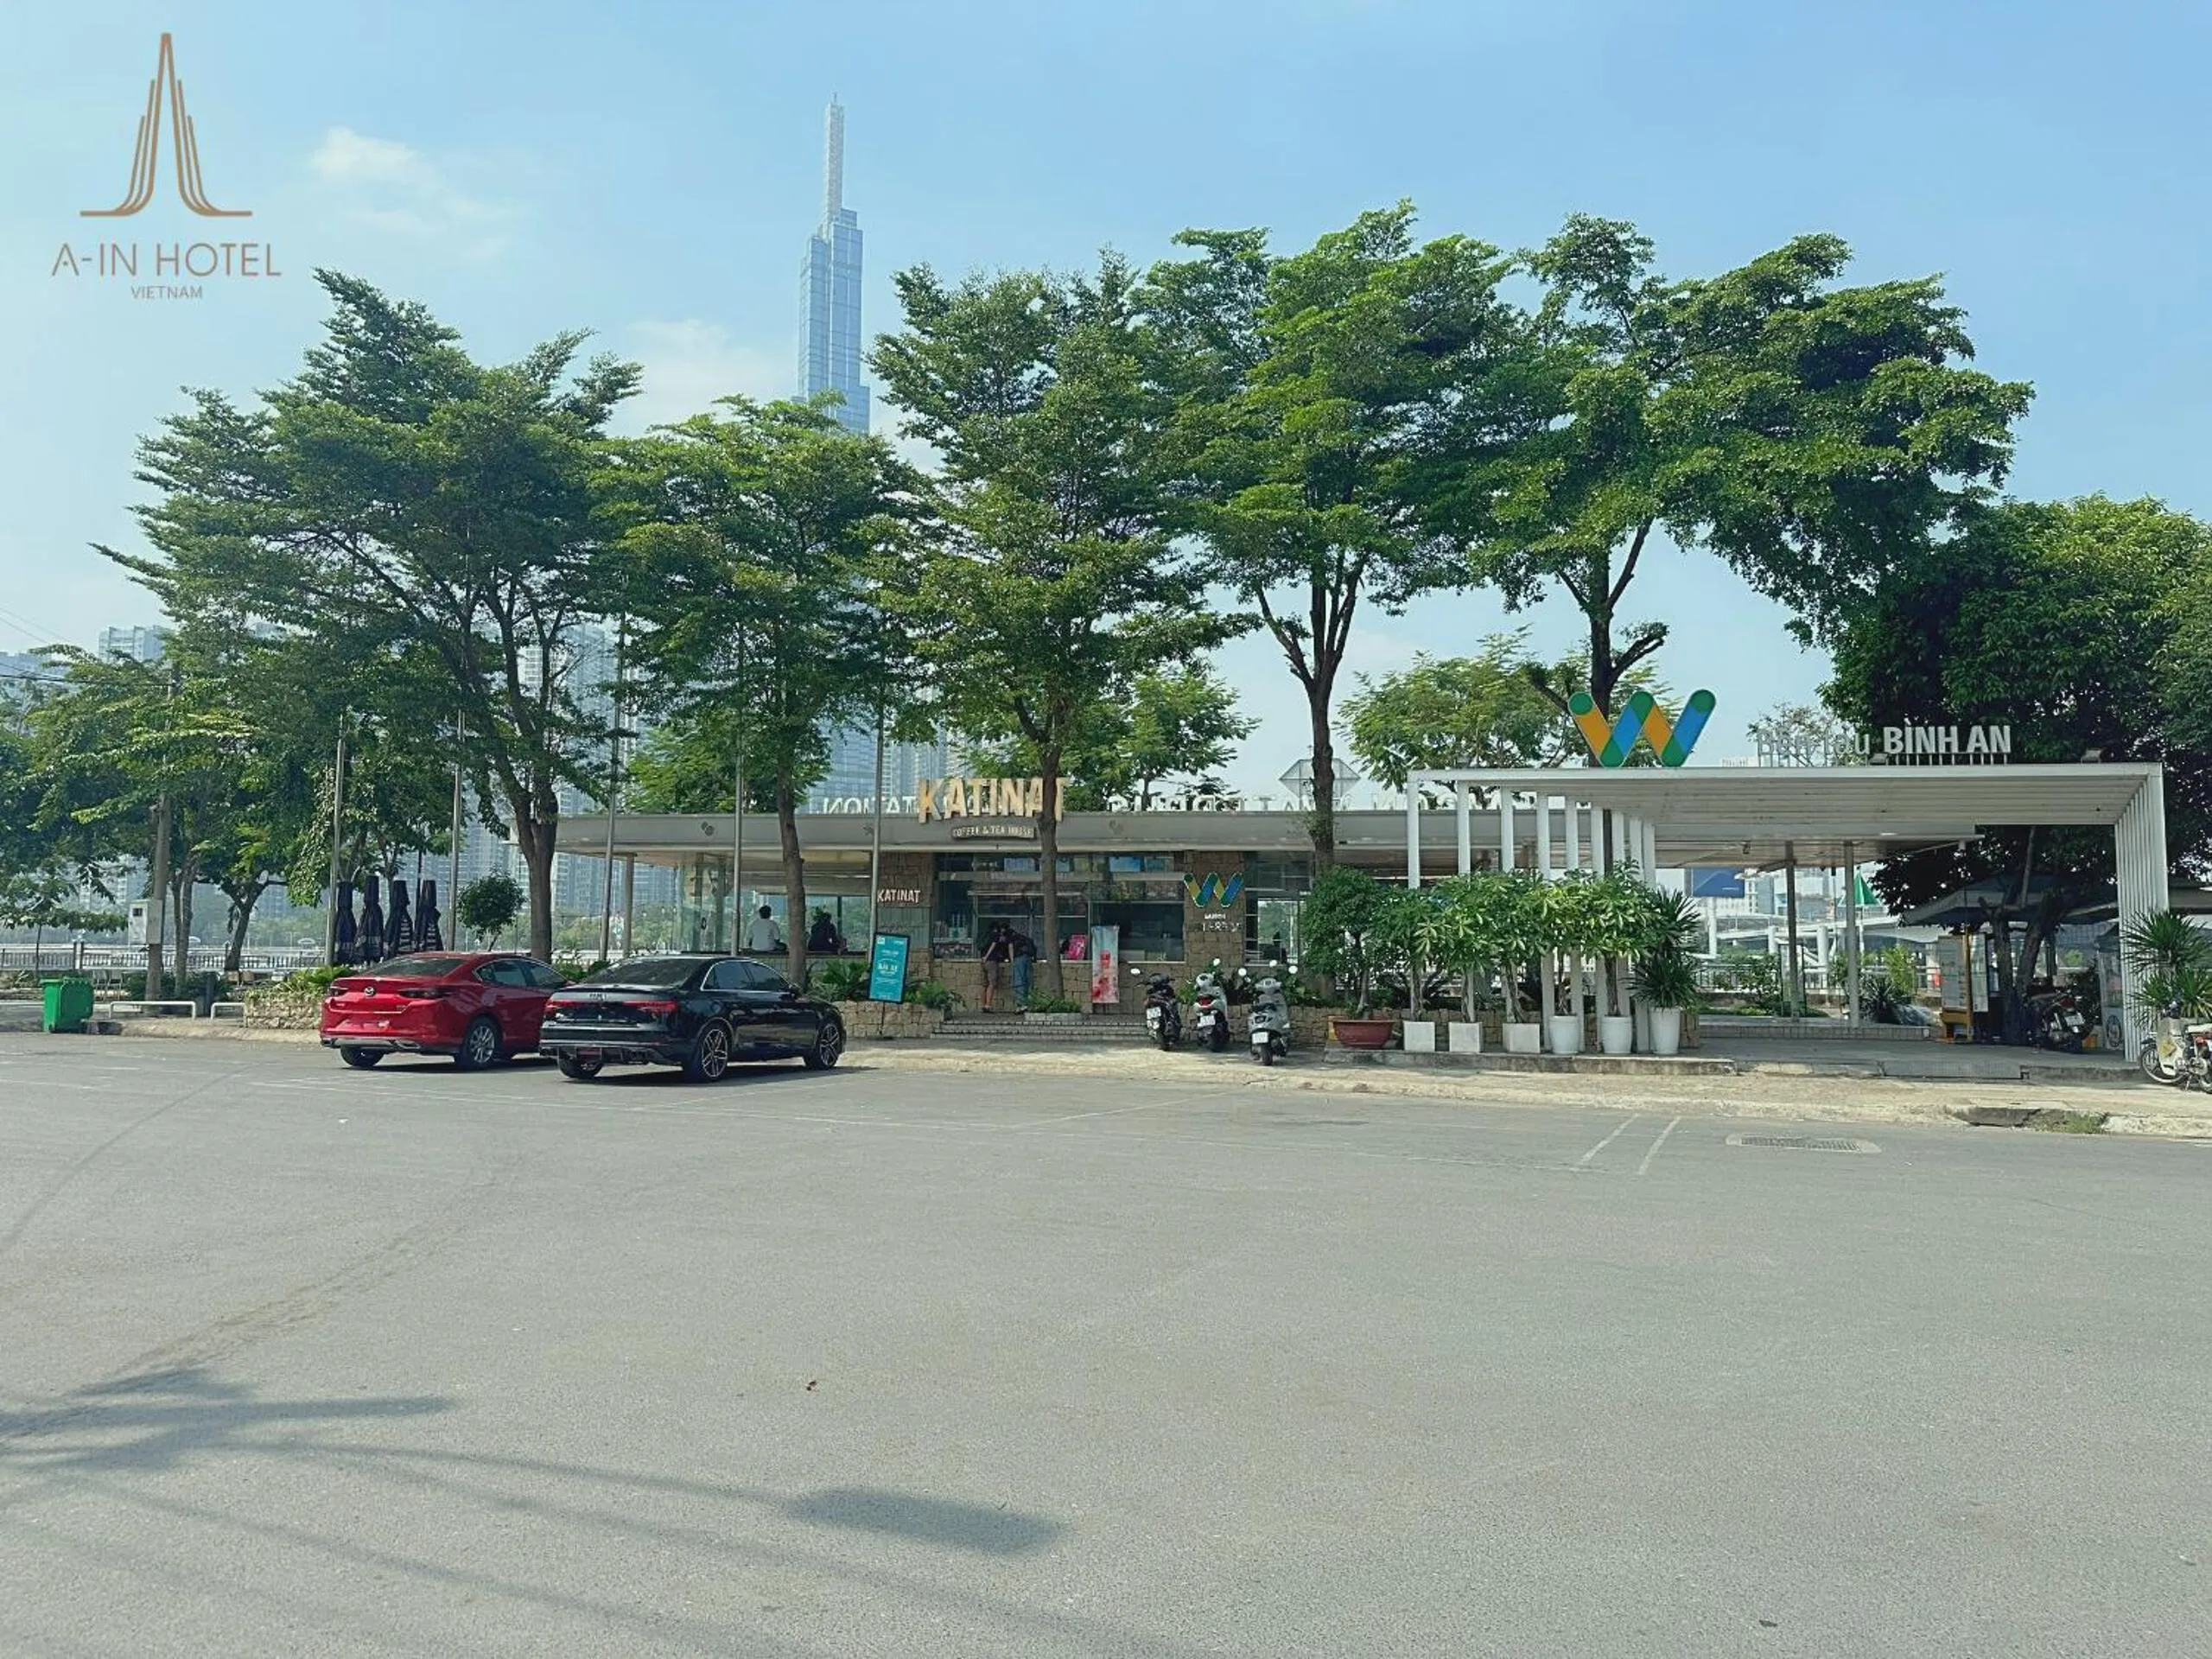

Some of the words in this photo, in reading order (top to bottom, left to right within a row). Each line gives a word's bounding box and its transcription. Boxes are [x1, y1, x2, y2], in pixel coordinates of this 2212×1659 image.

[1882, 718, 1959, 754] BÌNH
[1966, 724, 2012, 753] AN
[918, 777, 1071, 823] KATINAT
[877, 889, 921, 904] KATINAT
